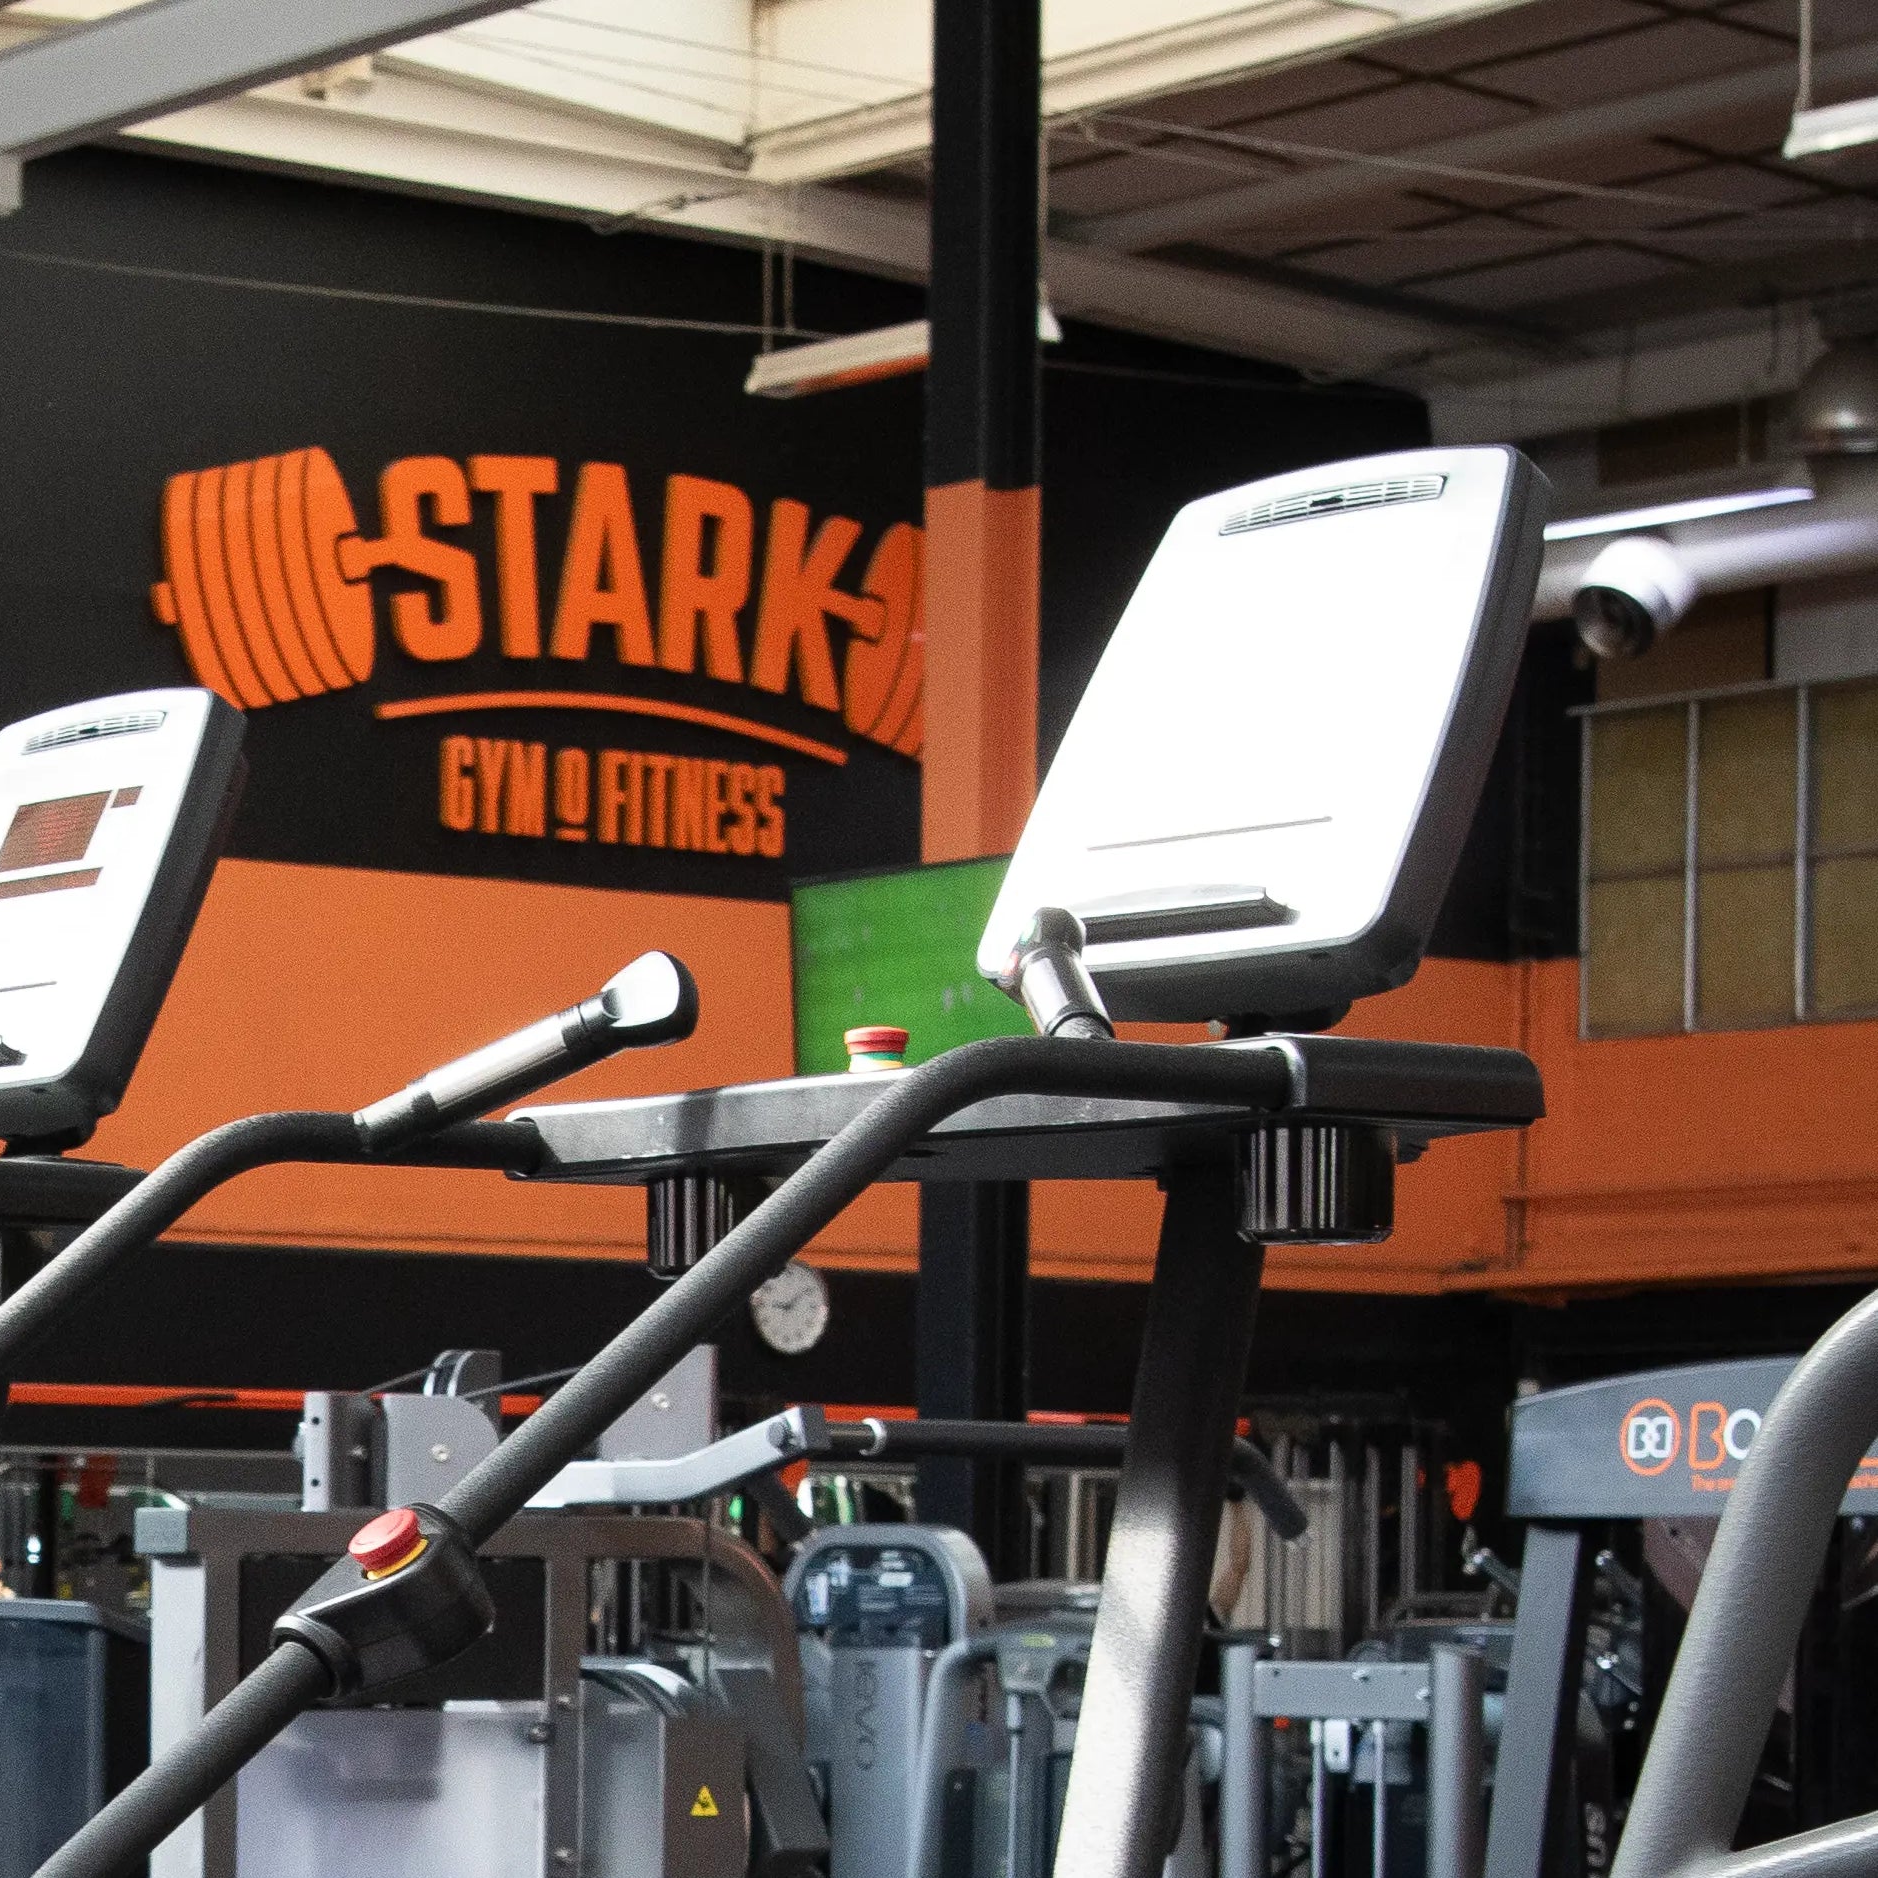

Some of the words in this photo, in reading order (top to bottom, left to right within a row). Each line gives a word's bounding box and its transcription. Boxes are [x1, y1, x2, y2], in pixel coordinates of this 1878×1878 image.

[378, 454, 864, 712] STARK
[439, 735, 547, 836] GYM
[598, 749, 786, 859] FITNESS
[1688, 1401, 1762, 1470] BO
